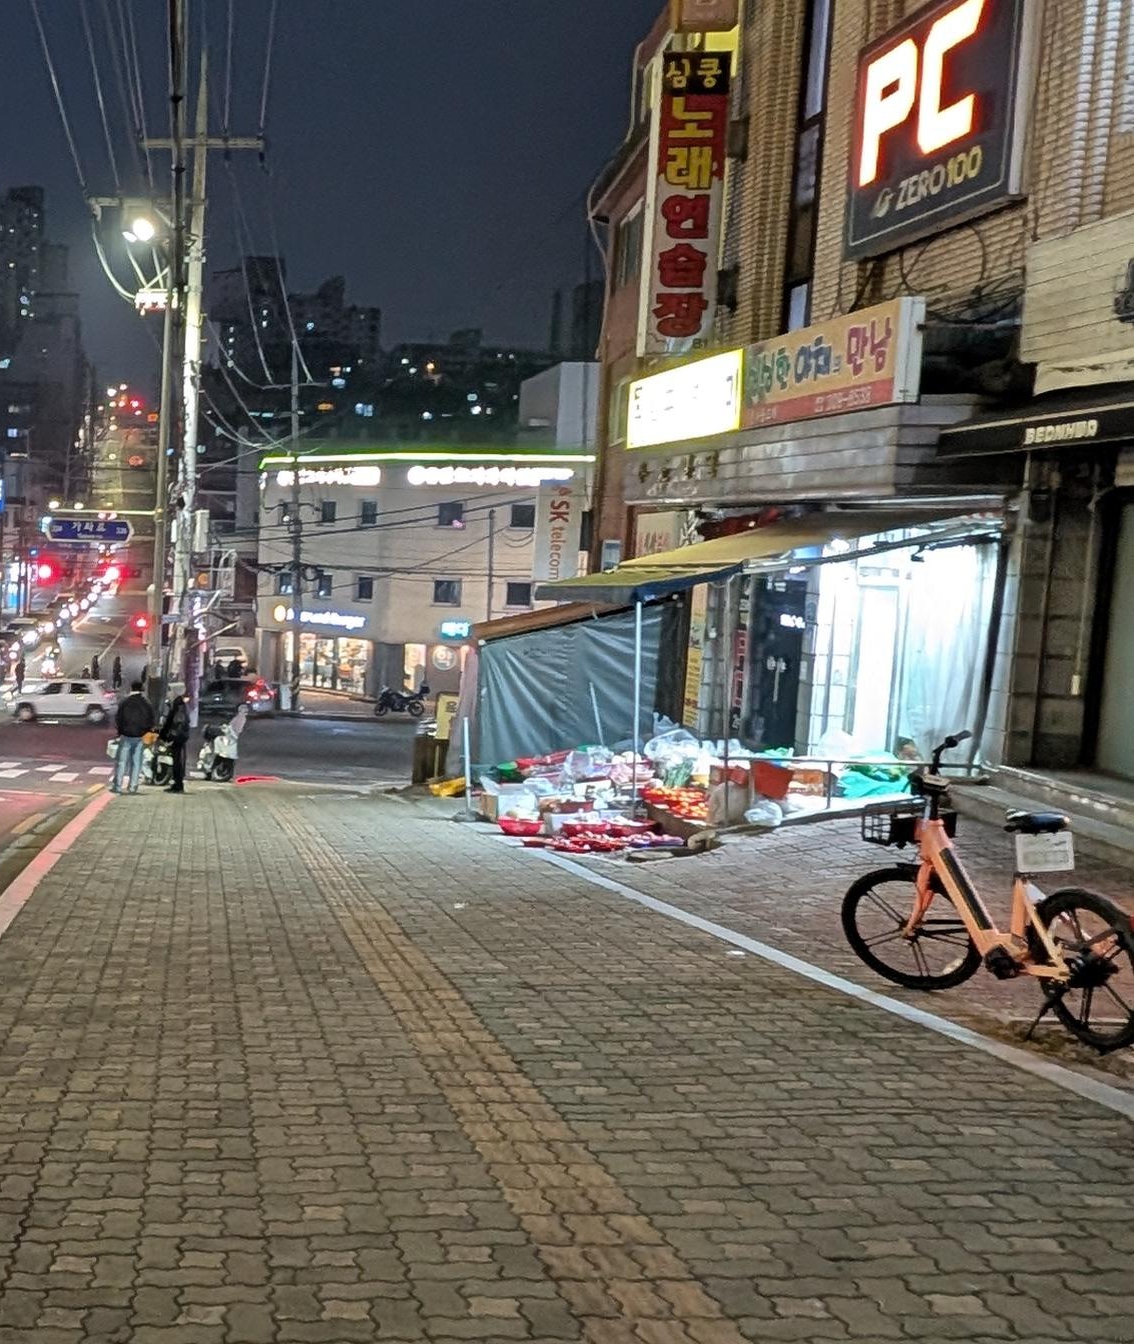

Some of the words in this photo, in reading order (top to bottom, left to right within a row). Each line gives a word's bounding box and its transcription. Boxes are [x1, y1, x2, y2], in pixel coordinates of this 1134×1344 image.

[665, 57, 722, 89] 심쿵
[894, 144, 983, 212] ZERO100
[652, 96, 714, 338] 노래연습장
[846, 317, 893, 377] 만남
[548, 499, 571, 523] SK
[548, 526, 567, 580] telecom
